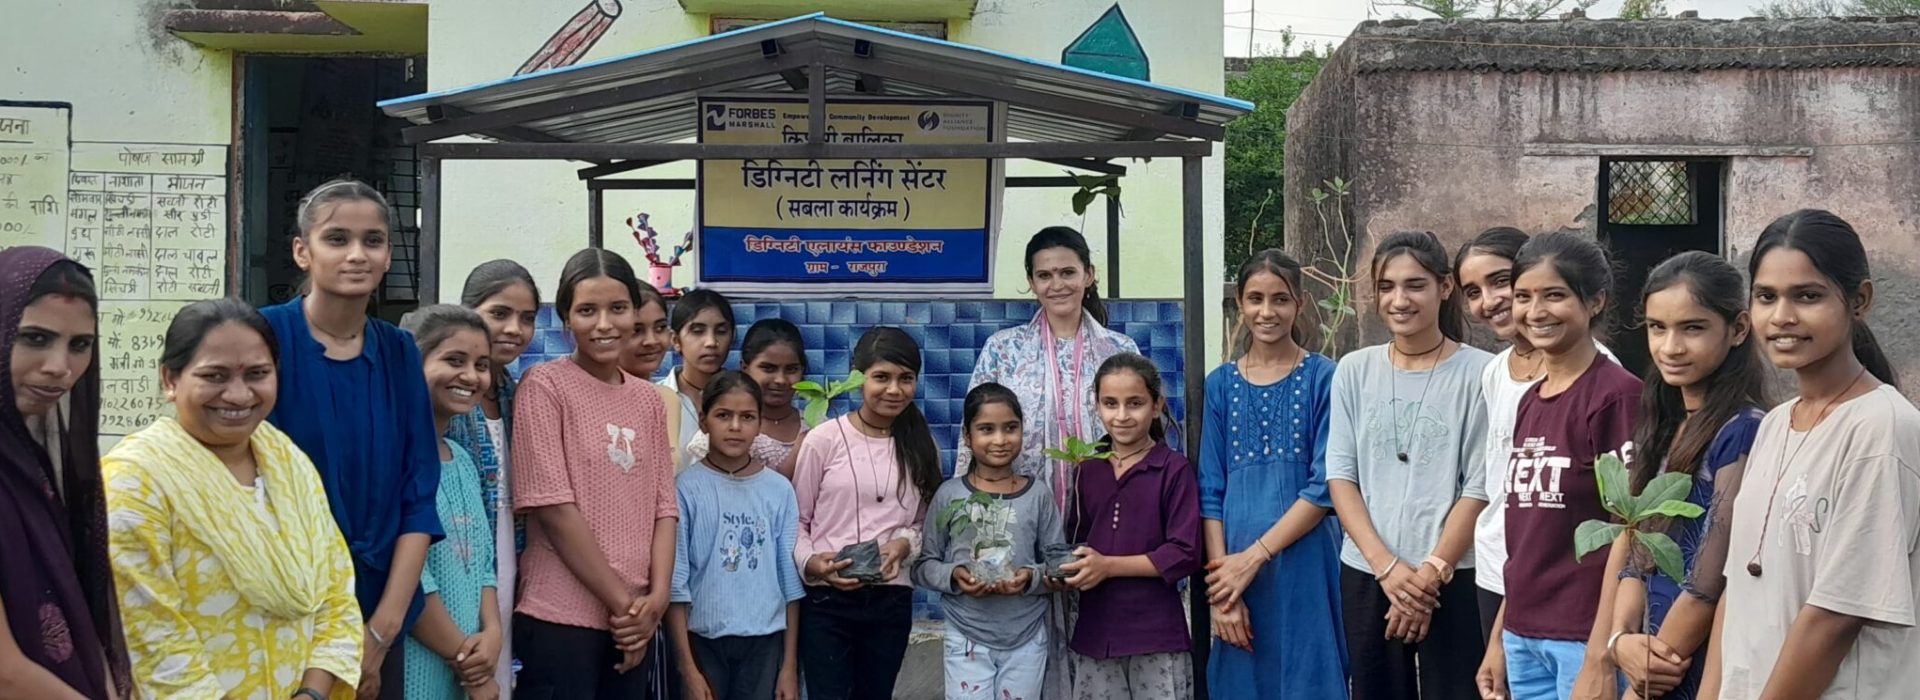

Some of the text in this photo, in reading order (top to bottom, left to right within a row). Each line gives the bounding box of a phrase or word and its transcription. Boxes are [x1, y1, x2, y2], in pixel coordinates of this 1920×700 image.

[729, 108, 776, 119] FORBES
[829, 113, 865, 121] Community
[868, 114, 910, 122] Development
[729, 121, 776, 129] MARSHALL
[741, 160, 947, 191] डिग्निटी लर्निंग सेंटर
[788, 200, 834, 218] सबला
[838, 193, 899, 220] कार्यक्रम
[155, 223, 217, 239] दाल रोटी
[744, 235, 801, 253] डिग्निटी
[804, 261, 829, 274] ग्राम
